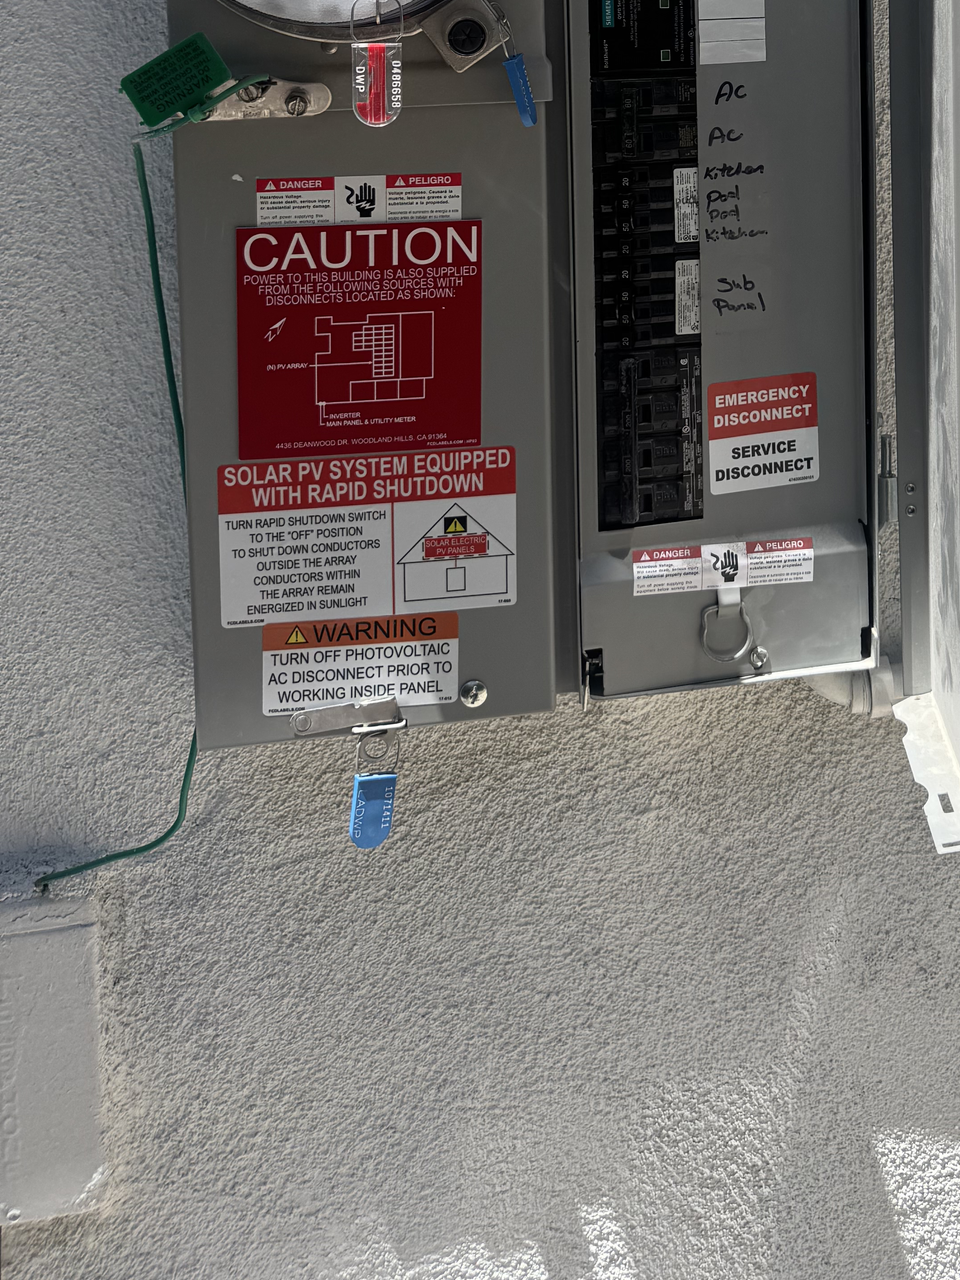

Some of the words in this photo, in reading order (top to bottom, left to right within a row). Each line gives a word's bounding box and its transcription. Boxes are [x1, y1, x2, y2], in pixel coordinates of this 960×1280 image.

[355, 66, 365, 92] DWP
[391, 60, 401, 108] 0486658
[155, 73, 213, 114] WARNING
[715, 81, 747, 105] AC
[280, 180, 322, 189] DANGER
[409, 176, 451, 184] PELIGRO
[244, 226, 477, 271] CAUTION
[244, 274, 284, 285] POWER
[287, 274, 301, 284] TO
[304, 273, 328, 283] THIS
[332, 270, 381, 281] BUILDING
[384, 270, 393, 279] IS
[396, 268, 423, 278] ALSO
[427, 266, 477, 277] SUPPLIED
[259, 284, 289, 295] FROM
[293, 283, 314, 294] THE
[317, 280, 380, 292] FOLLOWING
[383, 279, 434, 290] SOURCES
[437, 277, 463, 287] WITH
[266, 293, 343, 306] DISCONNECTS
[346, 291, 393, 302] LOCATED
[397, 291, 411, 299] AS
[414, 288, 455, 299] SHOWN:
[715, 385, 809, 408] EMERGENCY
[714, 404, 812, 428] DISCONNECT
[731, 440, 796, 460] SERVICE
[224, 463, 292, 486] SOLAR
[300, 461, 323, 481] PV
[331, 456, 408, 480] SYSTEM
[414, 448, 510, 474] EQUIPPED
[715, 457, 814, 481] DISCONNECT
[252, 486, 300, 507] WITH
[308, 481, 367, 503] RAPID
[373, 472, 484, 499] SHUTDOWN
[225, 520, 252, 530] TURN
[255, 518, 285, 528] RAPID
[288, 514, 345, 527] SHUTDOWN
[348, 510, 386, 523] SWITCH
[250, 534, 262, 543] TO
[265, 532, 284, 542] THE
[316, 526, 362, 538] POSITION
[767, 540, 803, 550] PELIGRO
[653, 549, 690, 559] DANGER
[313, 617, 436, 643] WARNING
[271, 651, 309, 667] TURN
[314, 650, 341, 663] OFF
[345, 643, 450, 662] PHOTOVOLTAIC
[268, 673, 288, 685] AC
[292, 666, 383, 684] DISCONNECT
[387, 663, 430, 677] PRIOR
[434, 662, 452, 673] TO
[278, 689, 345, 703] WORKING
[350, 684, 395, 699] INSIDE
[399, 681, 442, 695] PANEL
[354, 790, 365, 838] LADWP
